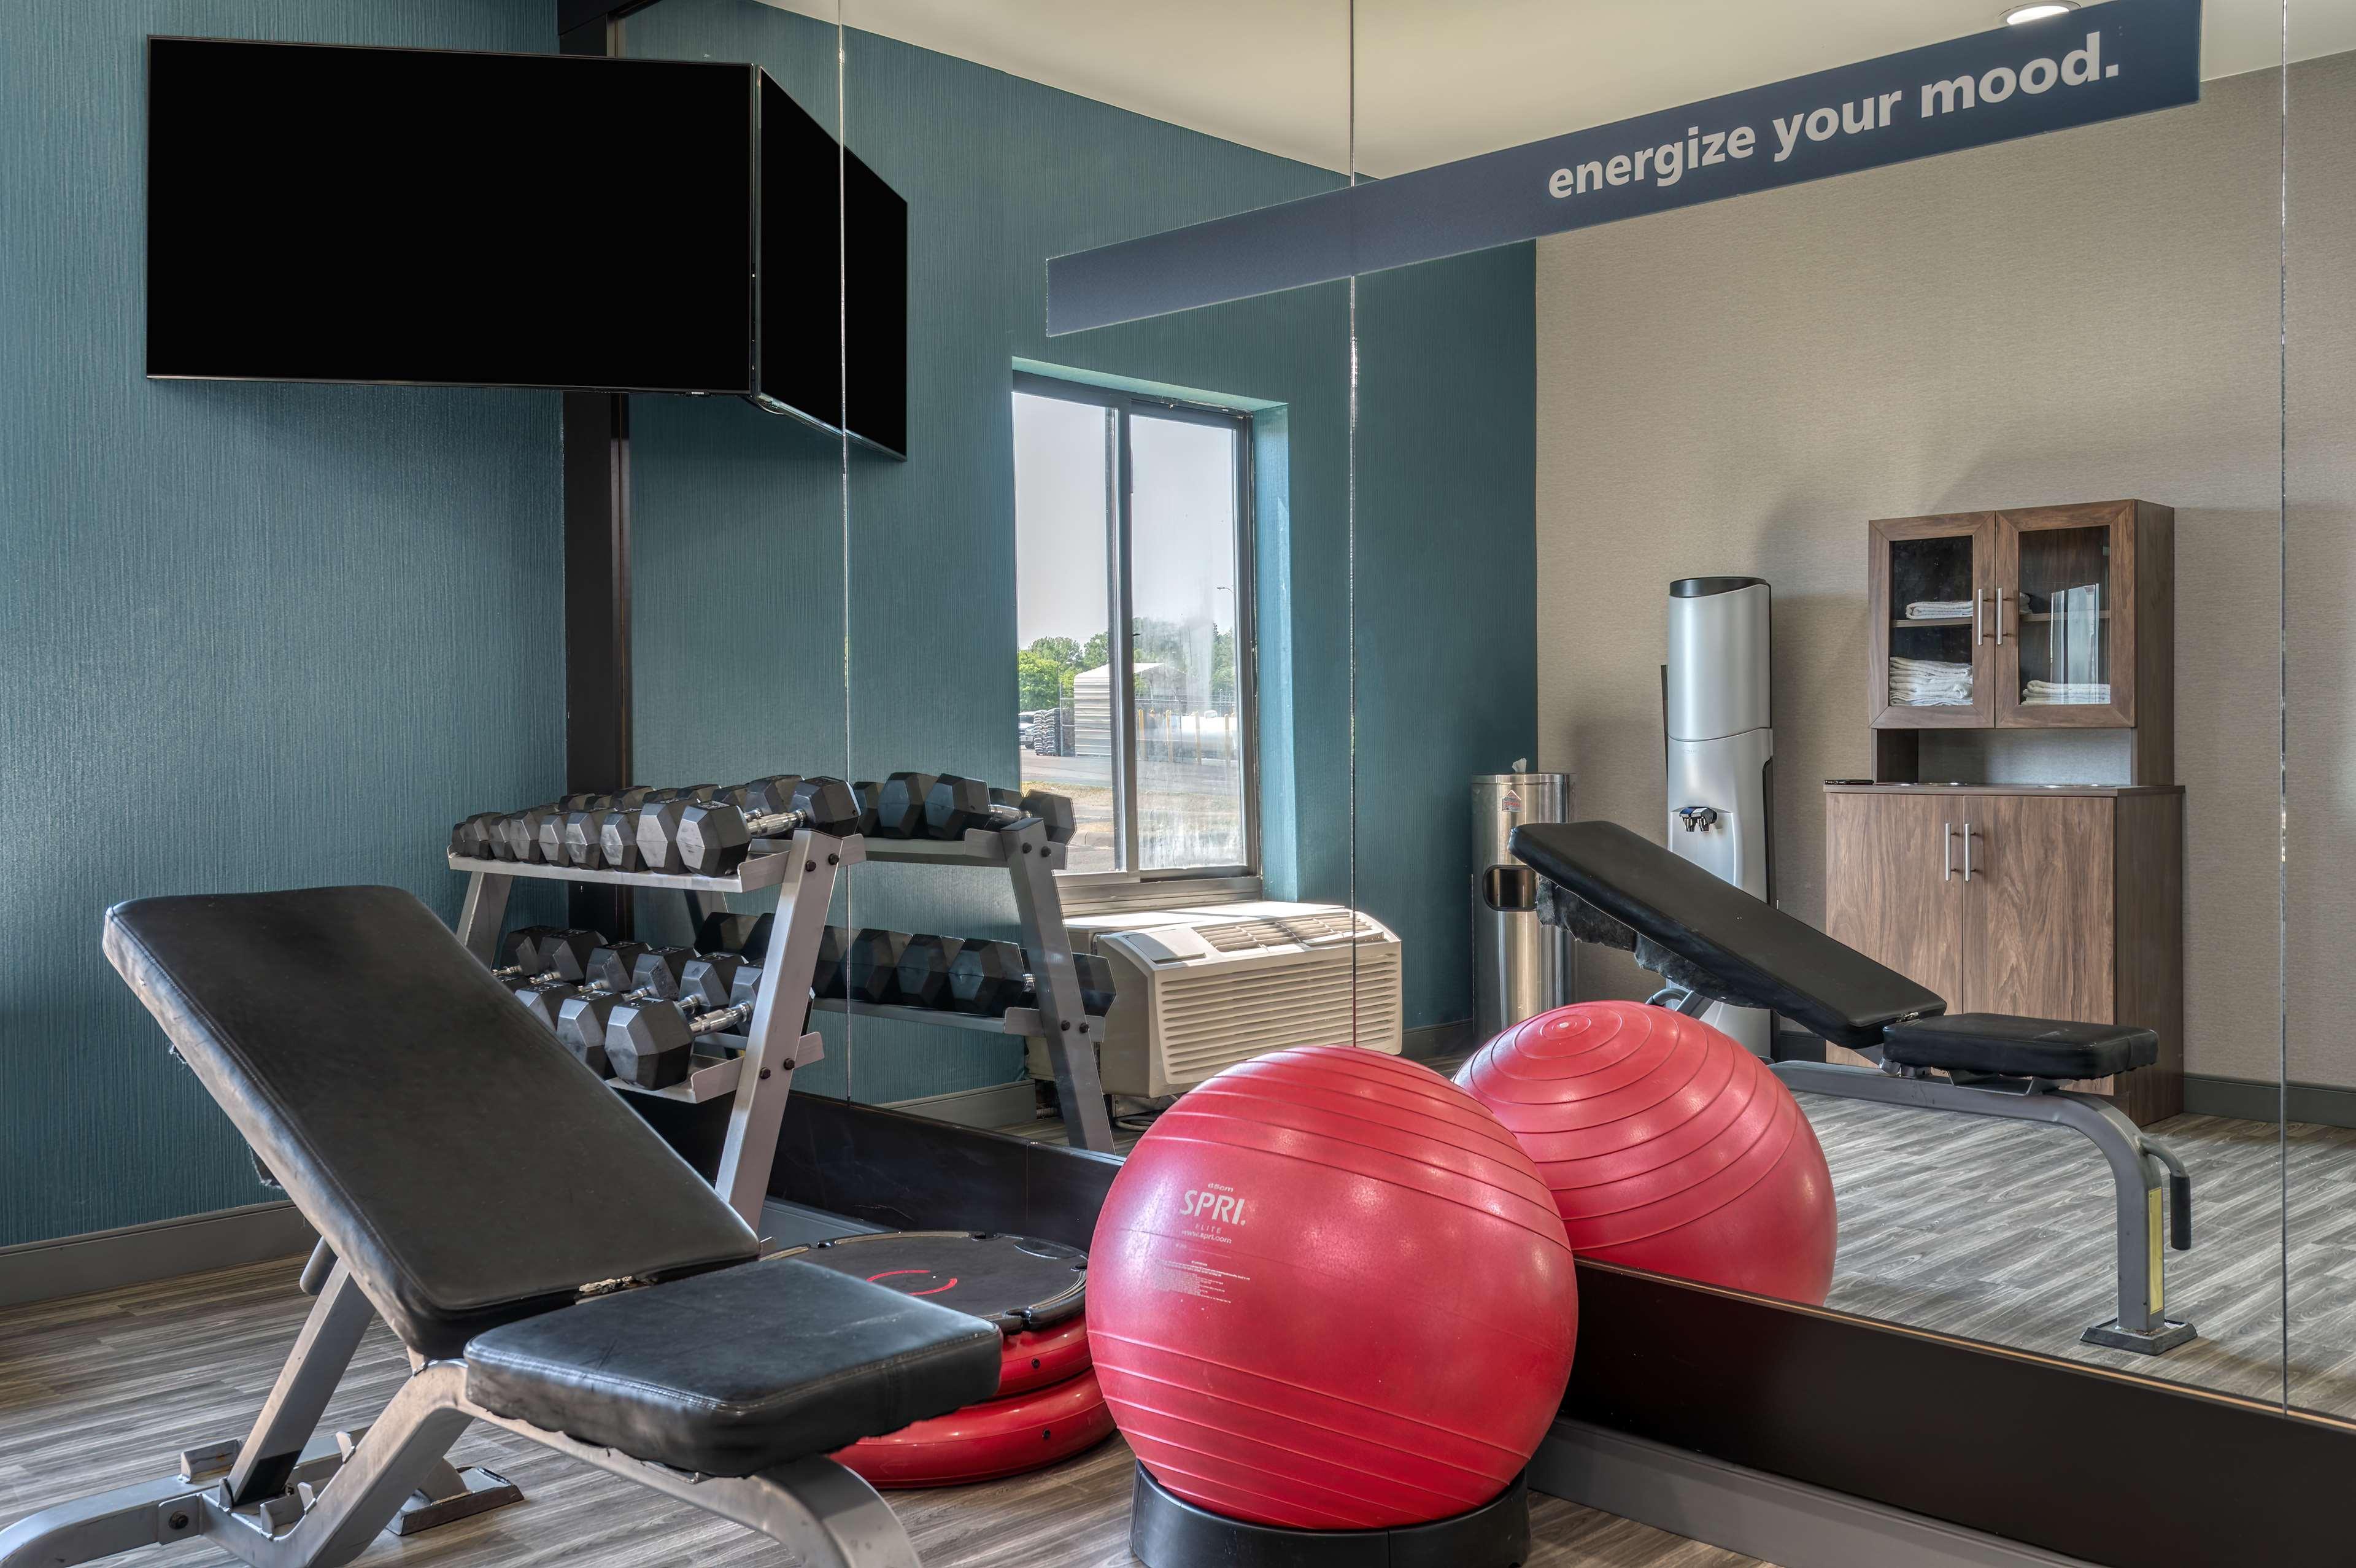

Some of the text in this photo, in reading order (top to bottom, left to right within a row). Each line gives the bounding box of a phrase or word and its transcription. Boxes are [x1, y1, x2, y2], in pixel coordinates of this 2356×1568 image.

[1548, 31, 2119, 199] energize your mood.
